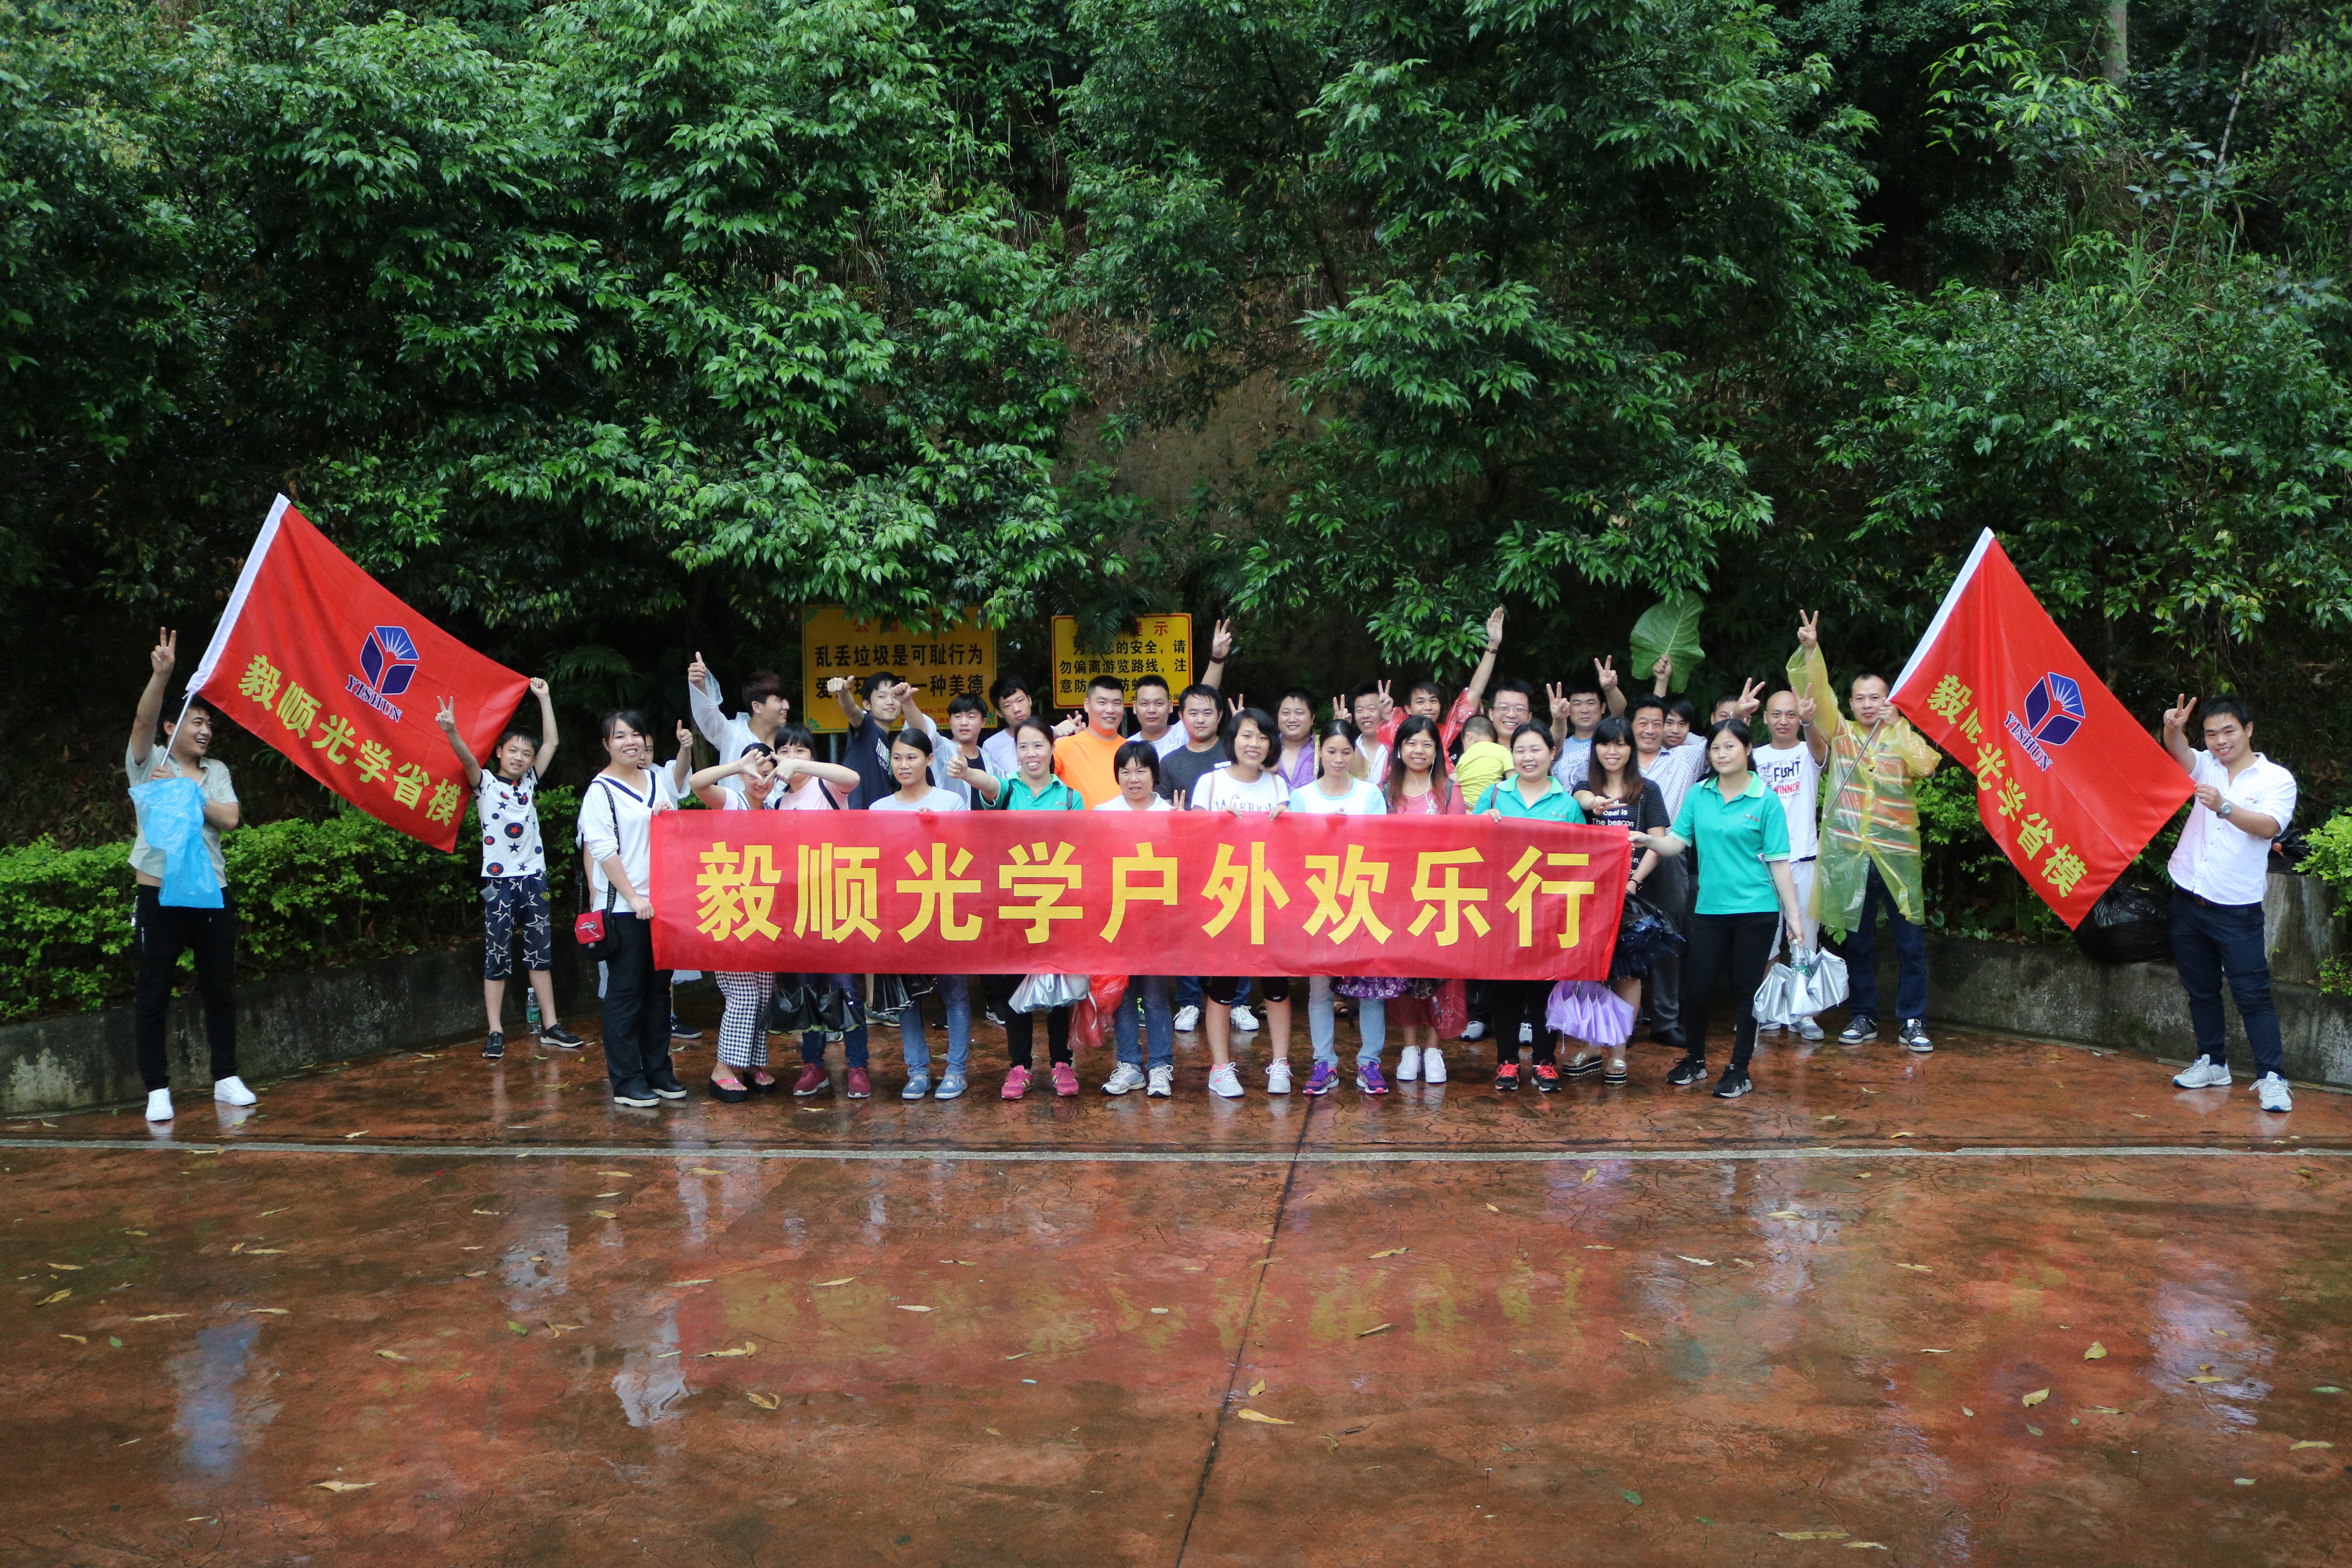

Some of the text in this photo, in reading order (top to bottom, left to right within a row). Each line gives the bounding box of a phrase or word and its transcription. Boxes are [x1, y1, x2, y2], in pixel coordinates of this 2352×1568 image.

[815, 643, 983, 667] 乱丢垃圾是可耻行为
[345, 674, 403, 723] YISHUN
[238, 655, 461, 826] 毅顺光学省模
[2004, 710, 2053, 772] YISHUN
[1772, 781, 1800, 795] WINNER
[1774, 761, 1801, 782] FIGHT
[696, 841, 1595, 949] 毅顺光学户外欢乐行
